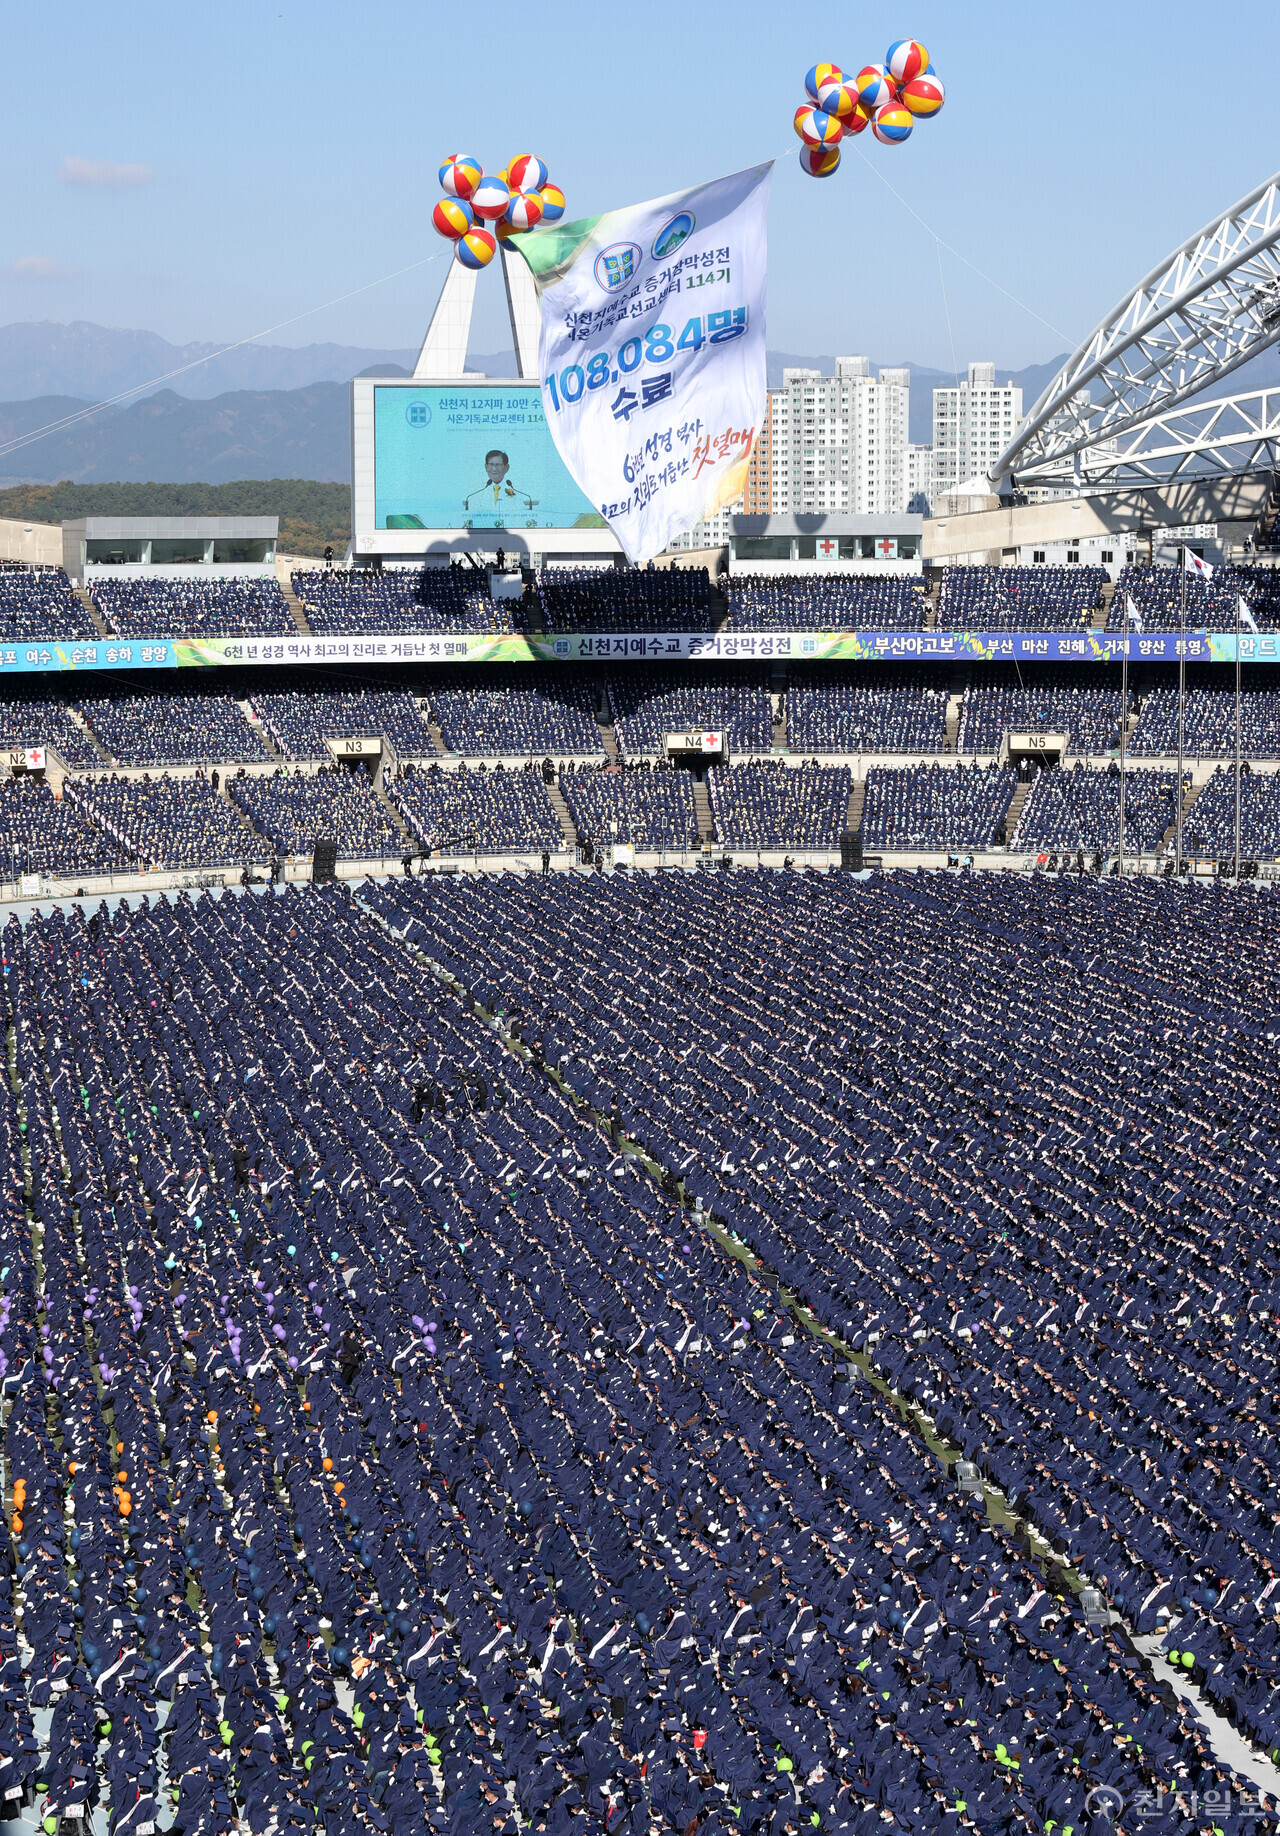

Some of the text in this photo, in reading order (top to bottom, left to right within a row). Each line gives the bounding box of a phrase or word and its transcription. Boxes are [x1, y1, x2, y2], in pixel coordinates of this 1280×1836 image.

[686, 267, 730, 289] 114기
[564, 247, 730, 328] 신천지예수교 증거장막성전
[438, 398, 543, 410] 신천지 12지파 10만 수
[611, 372, 672, 421] 수료
[446, 414, 525, 424] 시온기독교선교센터
[645, 427, 672, 461] 성경
[677, 418, 704, 446] 역사
[261, 645, 284, 658] 성경
[287, 644, 311, 658] 역사
[314, 644, 349, 657] 최고의
[352, 643, 387, 657] 진리로
[390, 643, 426, 656] 거듭난
[429, 643, 441, 656] 첫
[444, 642, 467, 656] 열매
[578, 637, 792, 656] 신천지예수교 증거장막성전
[874, 637, 956, 655] 부산야고보
[986, 639, 1085, 655] 부산 마산 진해
[1103, 639, 1202, 655] 거제 양산 통영
[26, 649, 52, 665] 여수
[71, 646, 167, 664] 순천 송하 광양
[345, 741, 363, 753] N3
[685, 736, 702, 747] N4
[1029, 737, 1046, 748] N5
[10, 752, 26, 765] N2
